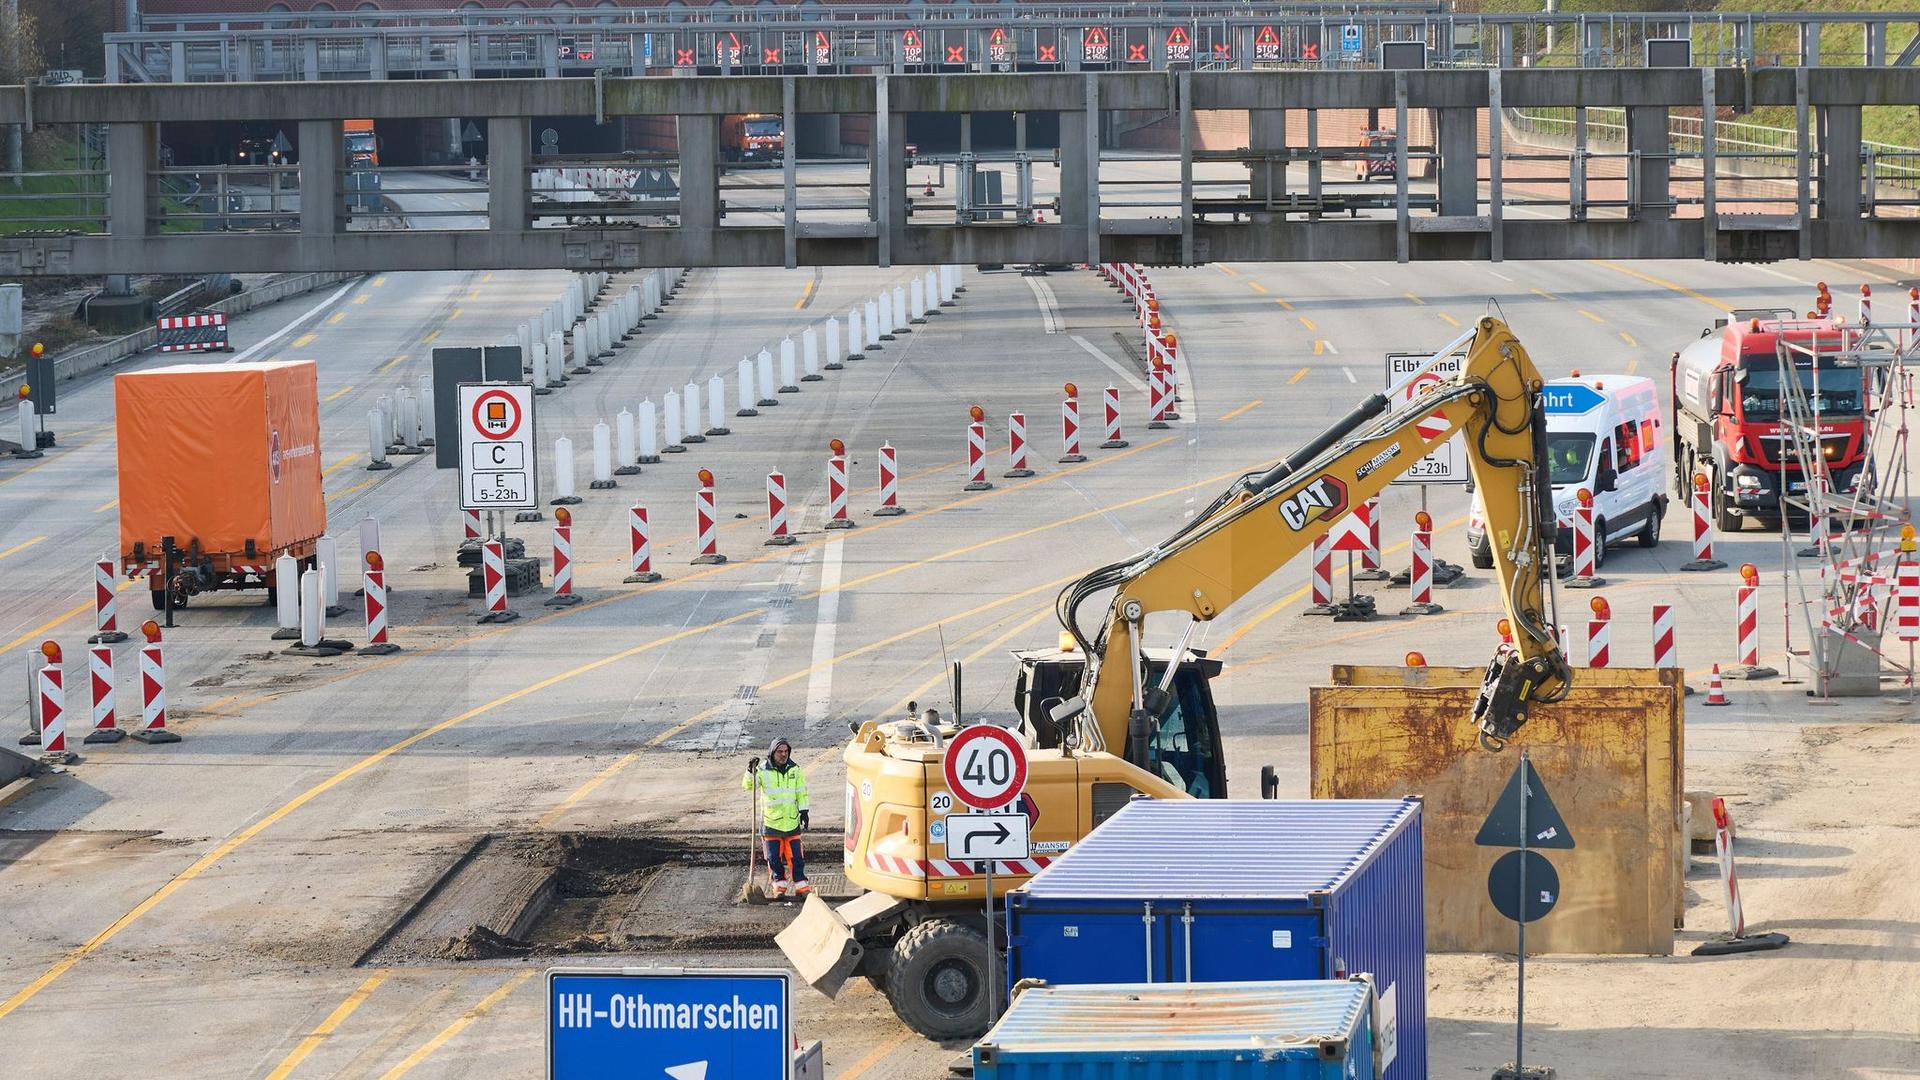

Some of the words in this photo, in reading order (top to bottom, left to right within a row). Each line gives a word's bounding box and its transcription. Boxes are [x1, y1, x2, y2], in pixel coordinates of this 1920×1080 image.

[1085, 46, 1108, 55] STOP
[1167, 45, 1189, 55] STOP
[492, 445, 505, 464] C
[1411, 462, 1448, 474] 5-23h
[496, 474, 504, 487] E
[481, 489, 518, 500] 5-23h
[1279, 478, 1333, 530] CAT
[962, 748, 1010, 786] 40
[862, 783, 871, 796] 20
[933, 795, 951, 809] 20
[559, 993, 778, 1030] HH-Othmarschen
